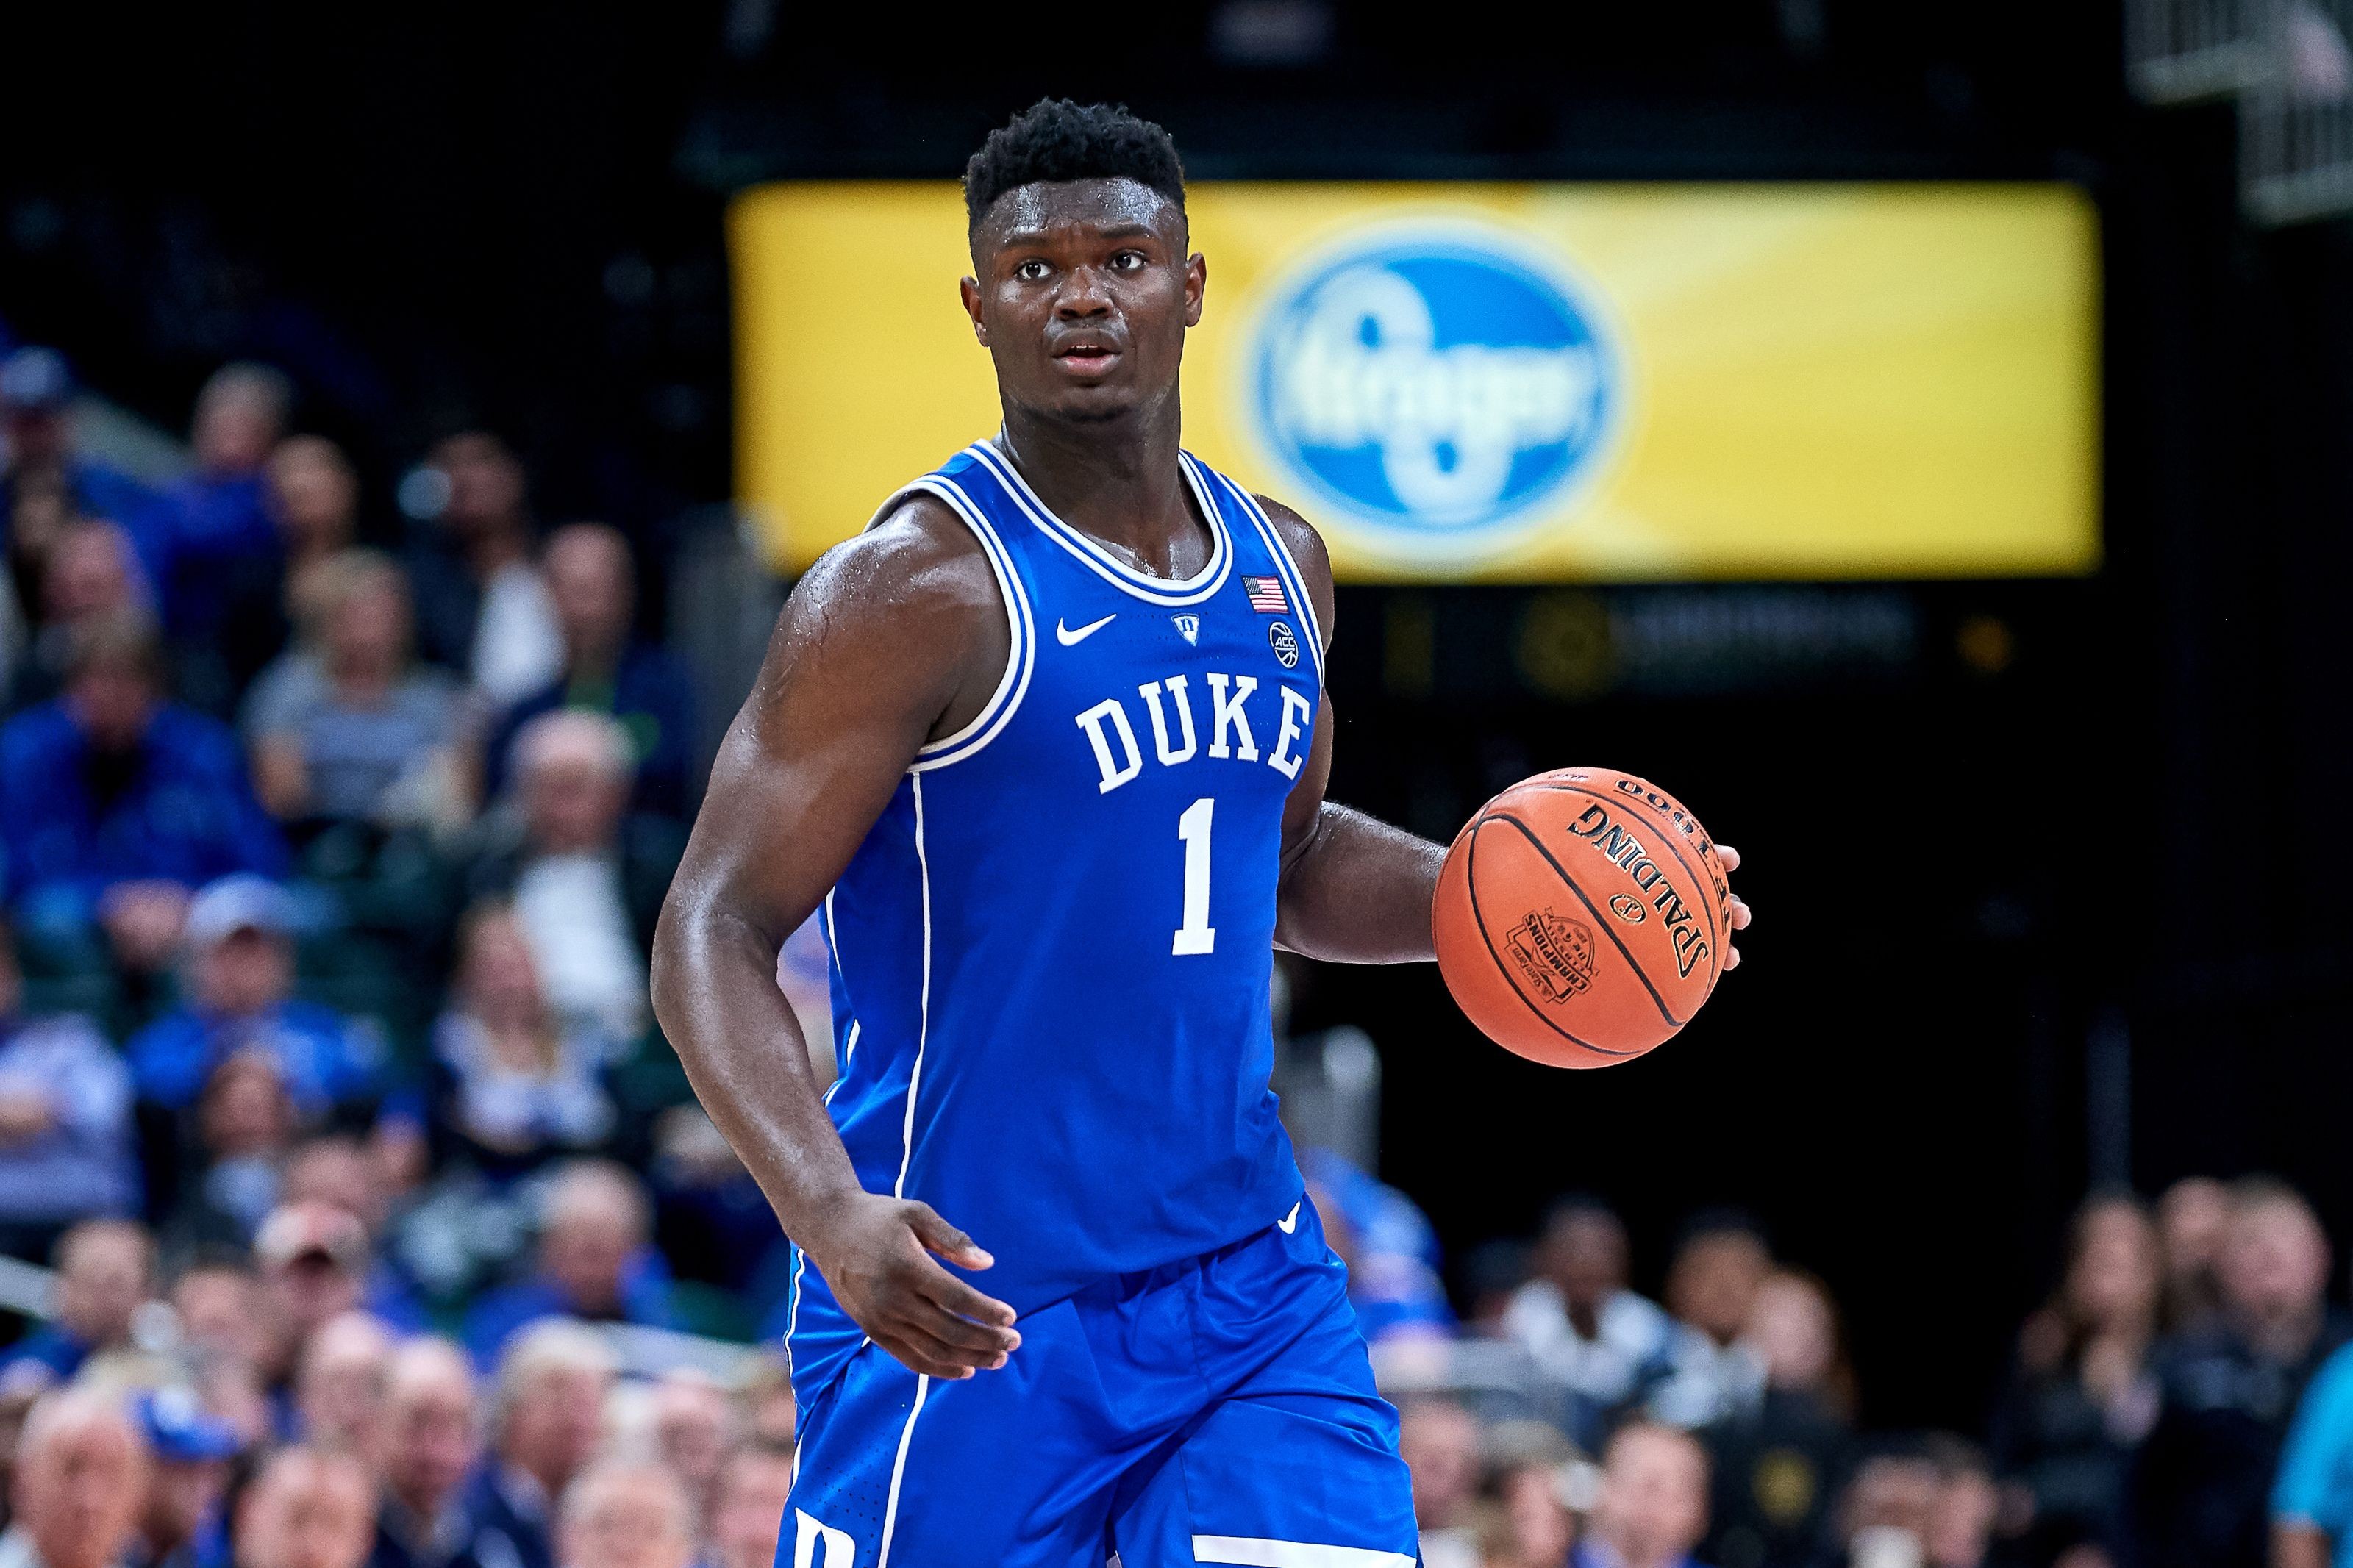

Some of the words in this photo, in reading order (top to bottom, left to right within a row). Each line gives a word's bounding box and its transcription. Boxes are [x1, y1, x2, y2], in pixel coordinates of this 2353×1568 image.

[1275, 636, 1296, 648] ACC
[1074, 672, 1310, 795] DUKE
[1172, 798, 1215, 956] 1
[1566, 802, 1710, 979] SPALDING
[1525, 913, 1588, 990] CHAMPIONS
